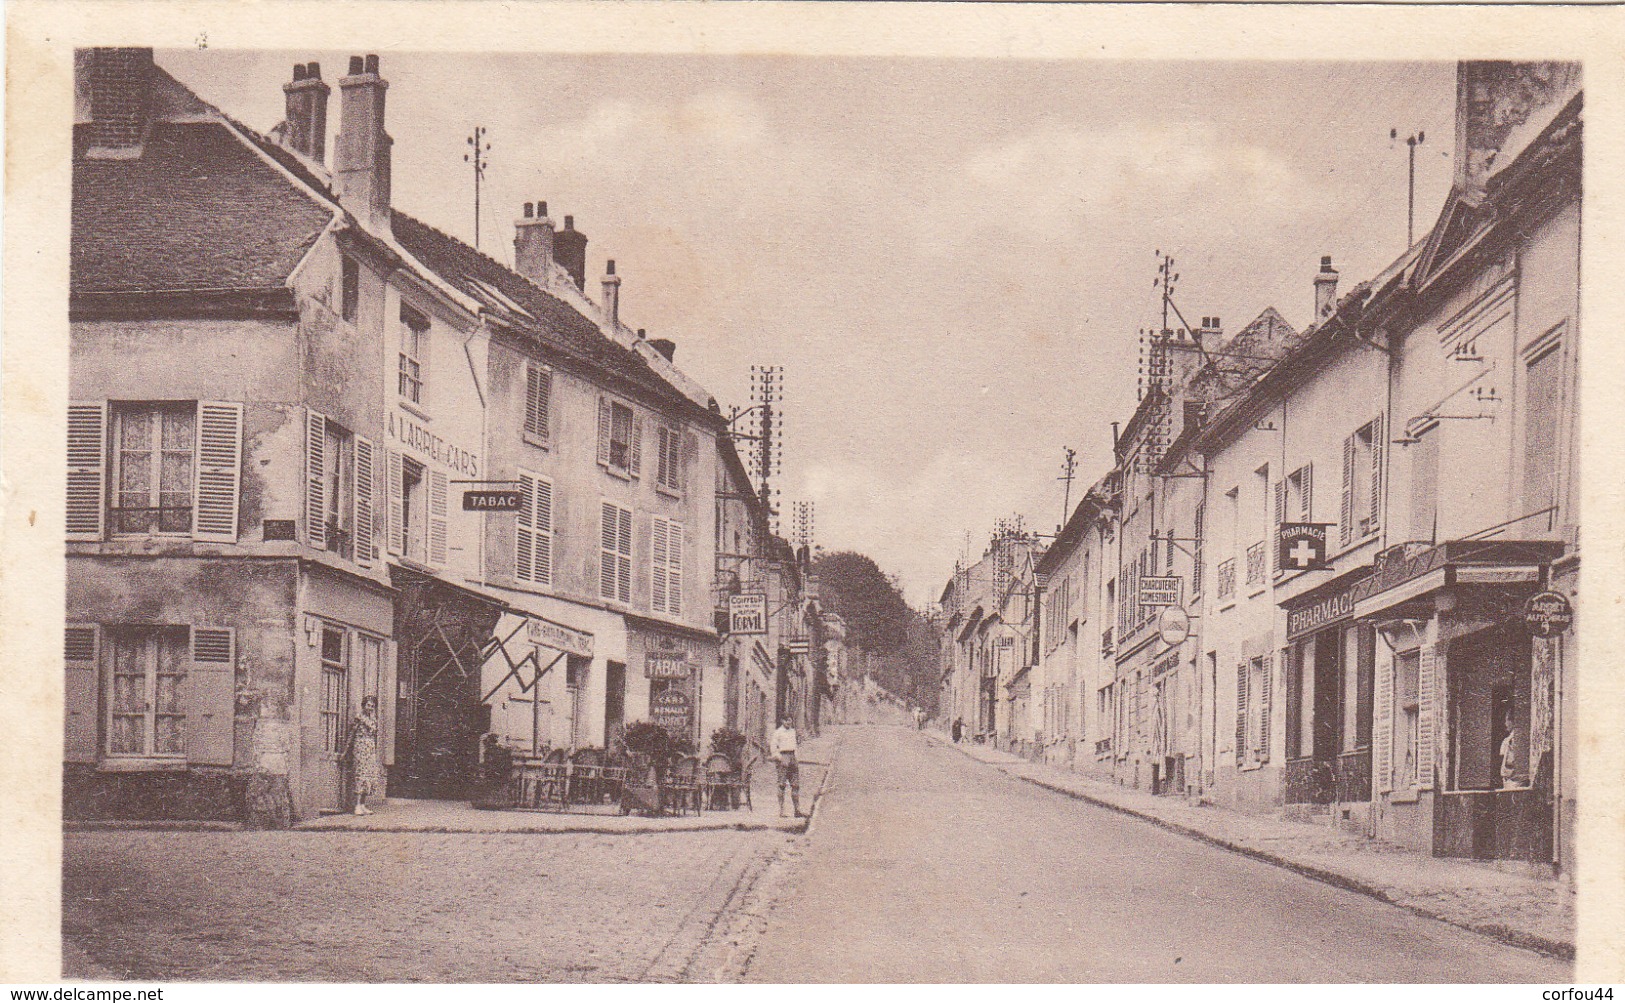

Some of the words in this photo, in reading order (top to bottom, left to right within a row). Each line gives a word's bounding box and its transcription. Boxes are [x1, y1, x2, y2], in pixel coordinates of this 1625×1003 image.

[447, 444, 478, 477] CARS
[470, 496, 517, 506] TABAC
[1281, 525, 1325, 541] PHARMACIE
[1141, 579, 1177, 590] CHARCUTERIE
[1141, 592, 1177, 603] COMESTIBLES
[733, 612, 764, 631] FORVIL
[648, 660, 686, 676] TABAC
[659, 696, 685, 704] CARS
[654, 706, 688, 714] RENAULT
